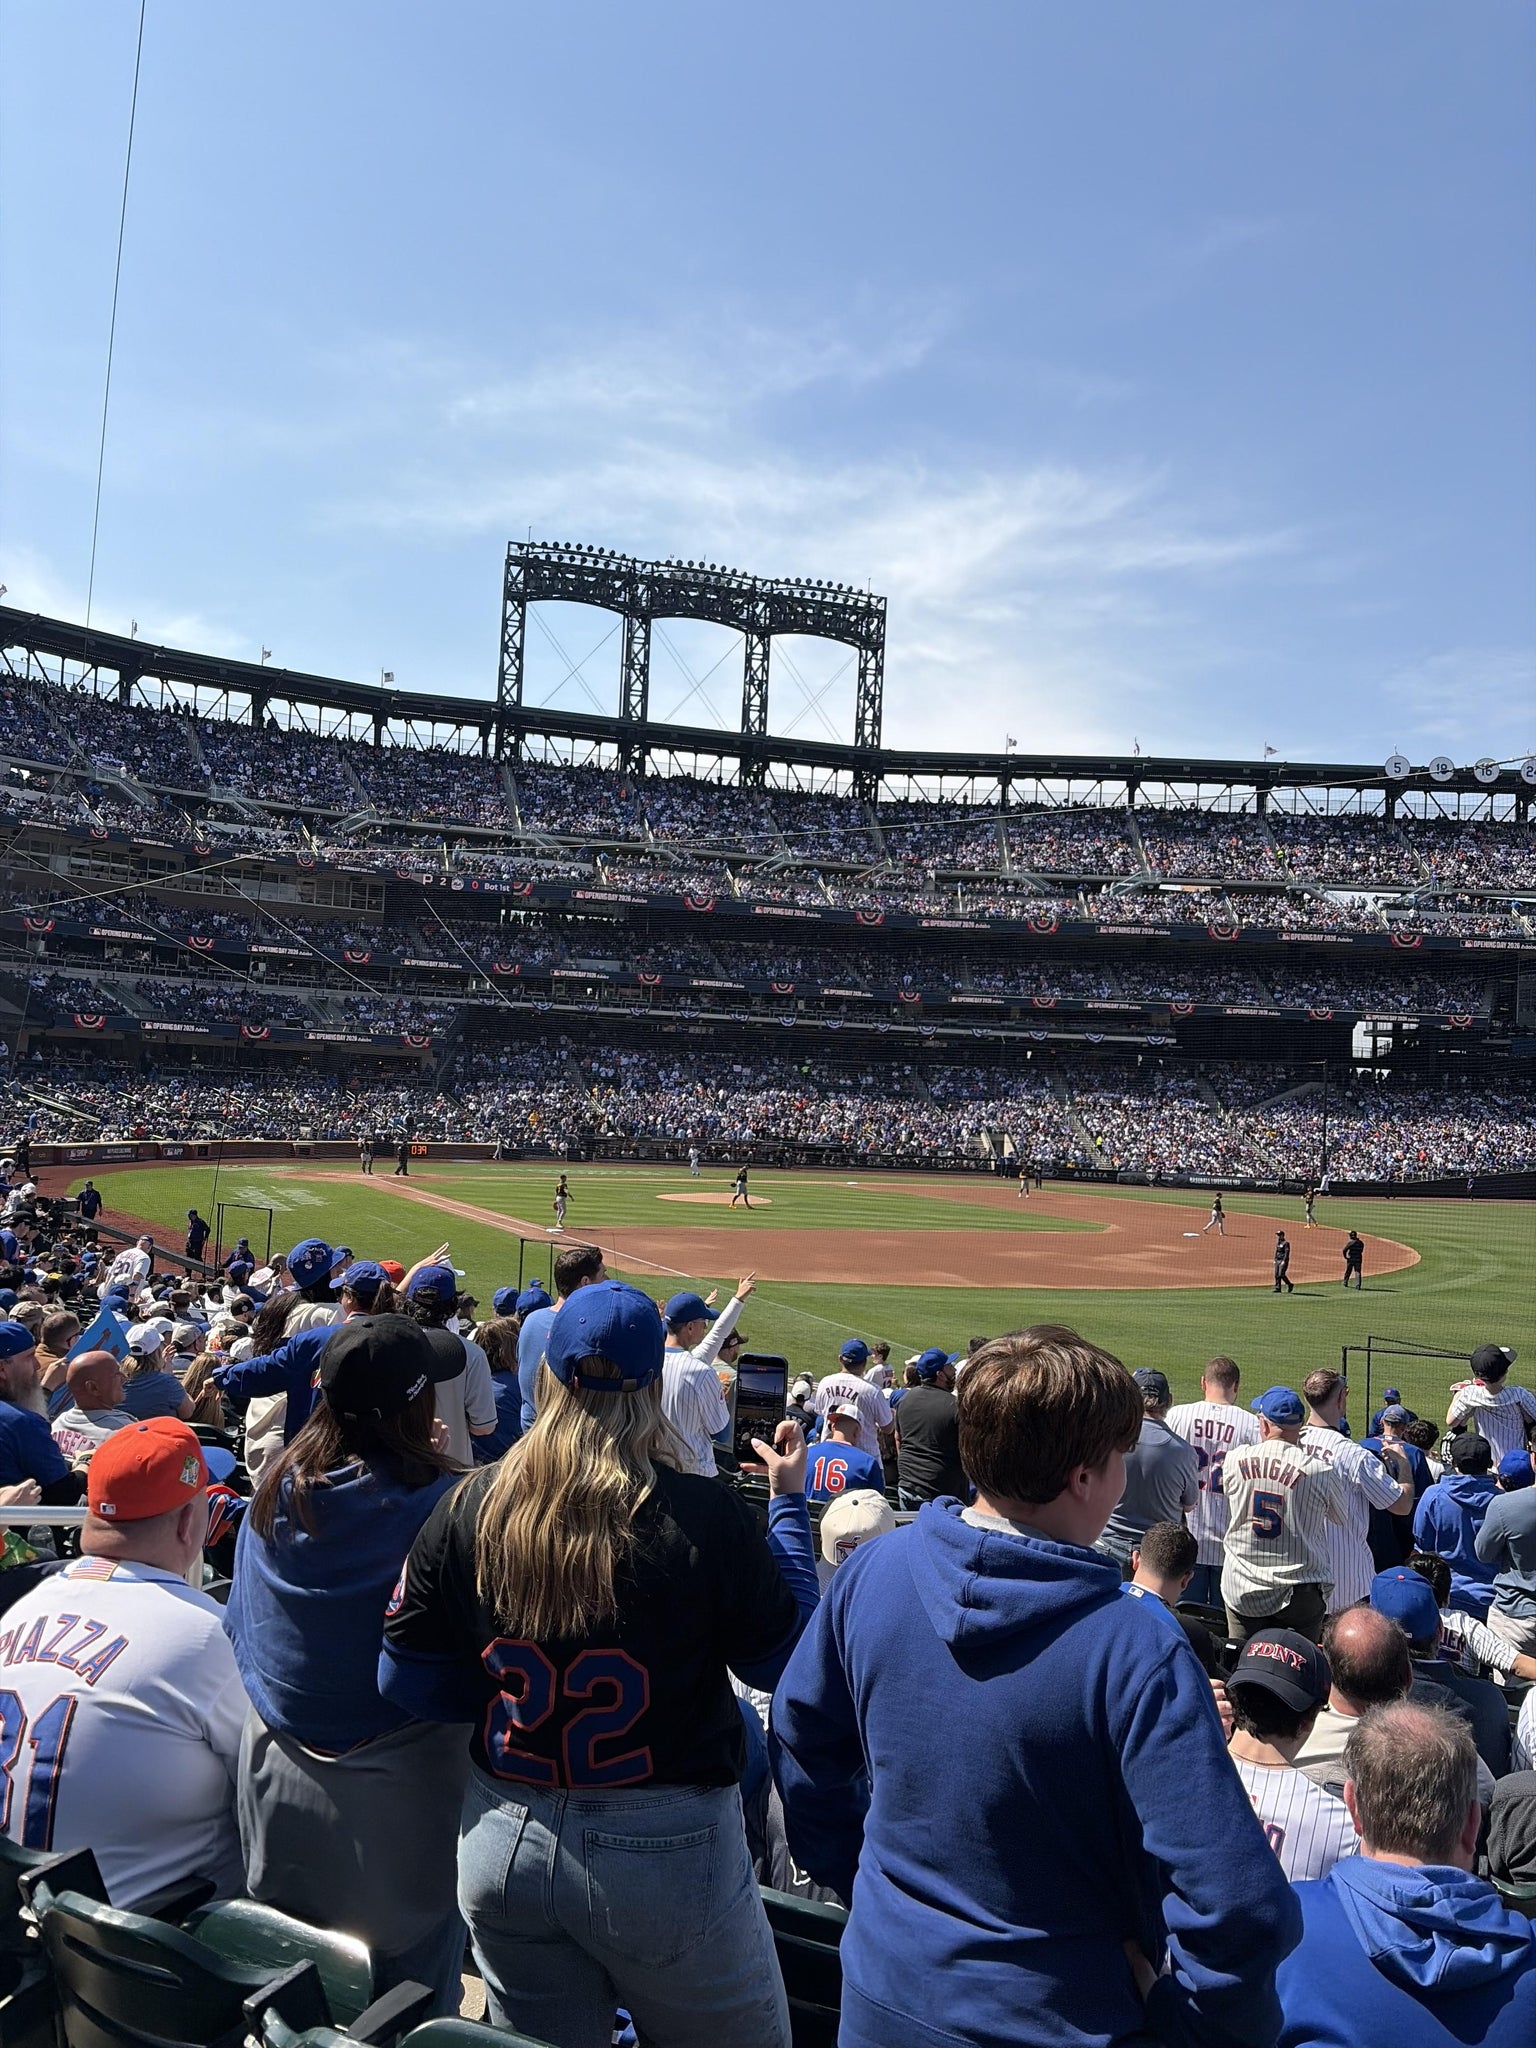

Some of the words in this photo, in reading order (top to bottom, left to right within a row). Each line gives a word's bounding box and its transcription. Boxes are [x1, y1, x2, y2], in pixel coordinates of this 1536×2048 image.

[1394, 762, 1400, 774] 5
[440, 877, 447, 886] 2
[472, 881, 478, 889] 0
[500, 884, 510, 892] 1st
[585, 892, 607, 900] OPENING
[764, 907, 784, 915] OPENING
[102, 929, 121, 938] OPENING
[826, 1386, 859, 1402] PIAZZA
[1194, 1418, 1235, 1444] SOTO
[814, 1456, 848, 1493] 16
[1238, 1456, 1307, 1490] WRIGHT
[1252, 1489, 1283, 1539] 5
[1247, 1642, 1306, 1671] FDNY
[482, 1637, 654, 1790] 22
